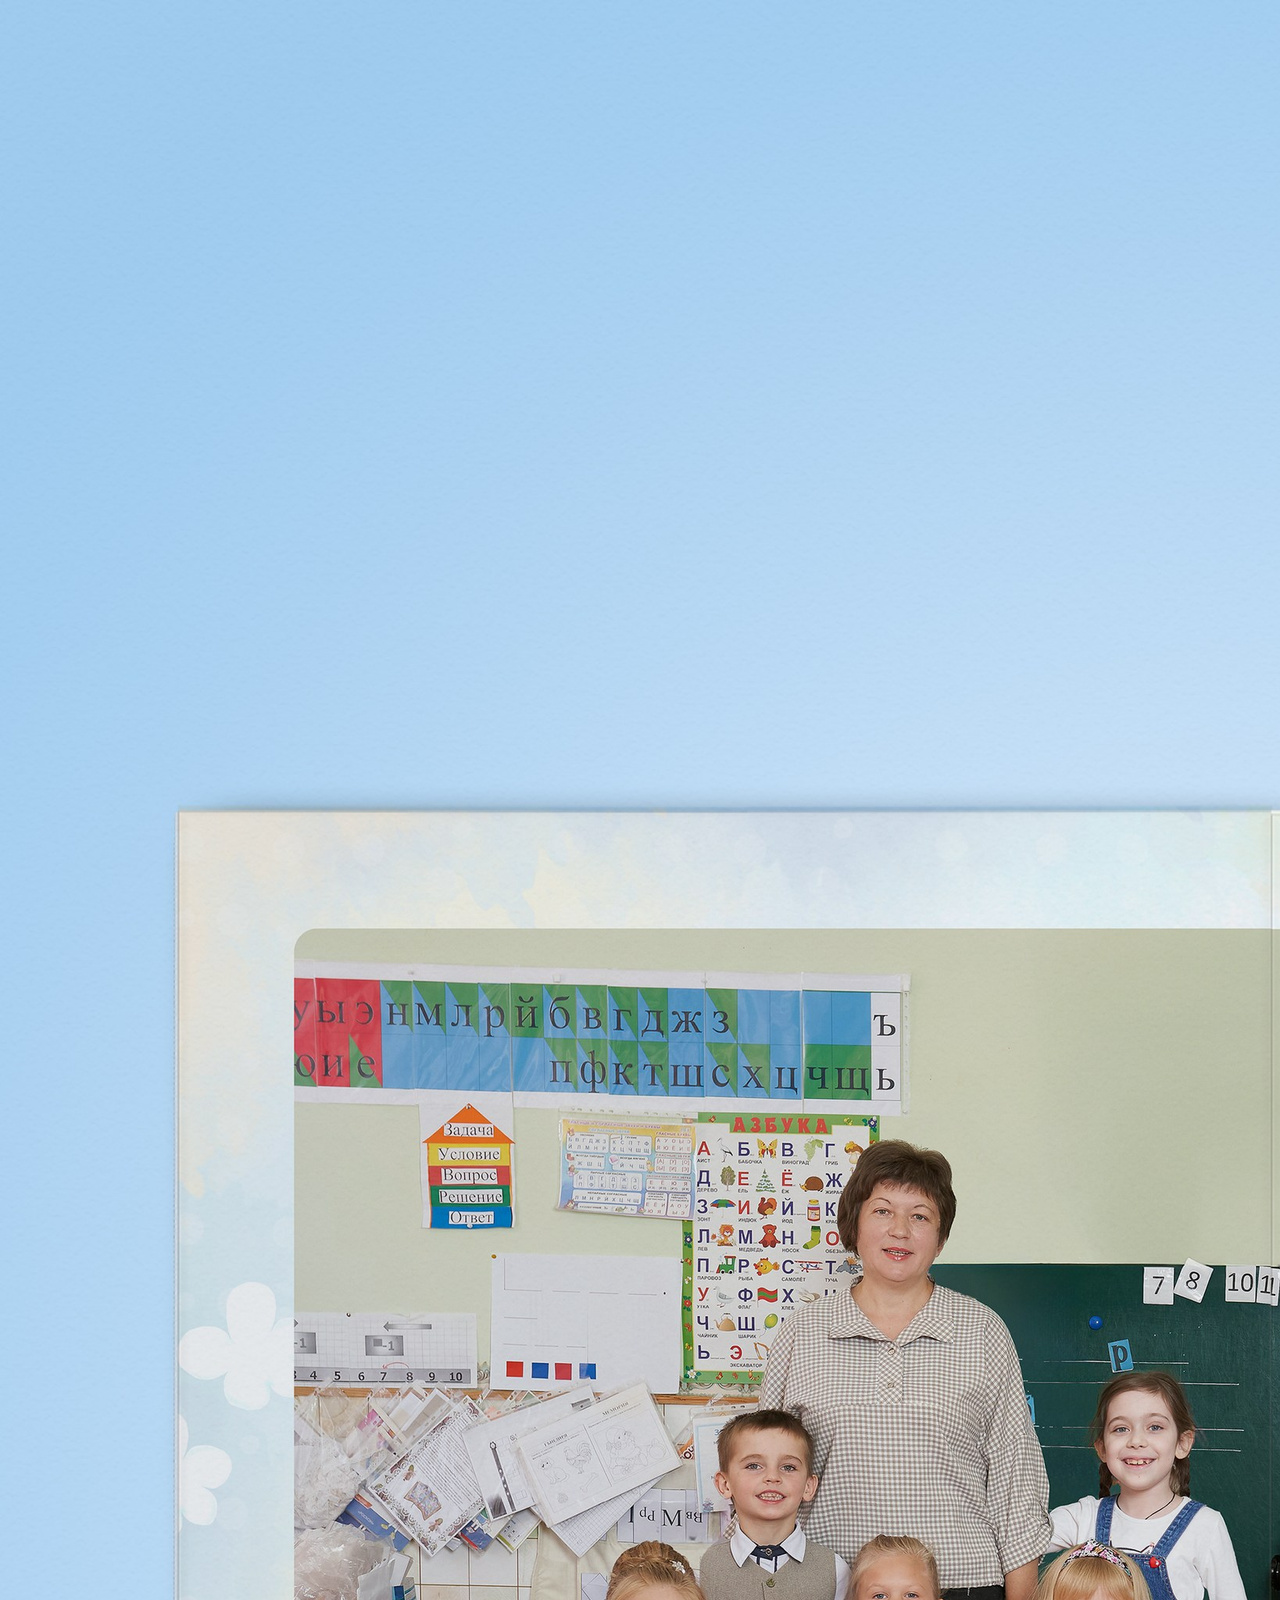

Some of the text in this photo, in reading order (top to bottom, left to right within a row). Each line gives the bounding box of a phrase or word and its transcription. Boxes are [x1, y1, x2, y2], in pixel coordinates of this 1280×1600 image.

[444, 1123, 494, 1137] Задача
[733, 1117, 828, 1134] АЗБУКА
[438, 1148, 500, 1160] Условие
[697, 1141, 711, 1155] А
[738, 1142, 750, 1156] Б
[782, 1143, 794, 1157] В
[825, 1143, 835, 1157] Г
[443, 1168, 497, 1184] Вопрос
[697, 1170, 711, 1187] Д
[738, 1171, 749, 1185] Е
[782, 1169, 793, 1186] Ё
[825, 1172, 843, 1187] Ж
[439, 1190, 503, 1203] Решение
[697, 1199, 708, 1214] З
[738, 1200, 750, 1215] И
[782, 1198, 794, 1215] Й
[825, 1202, 836, 1216] К
[450, 1211, 493, 1223] Ответ
[697, 1229, 710, 1243] Л
[739, 1229, 752, 1244] М
[782, 1230, 794, 1245] Н
[825, 1231, 839, 1246] О
[697, 1258, 709, 1272] П
[738, 1259, 750, 1273] Р
[782, 1259, 794, 1274] С
[825, 1261, 837, 1274] Т
[1152, 1276, 1164, 1295] 7
[1186, 1271, 1200, 1290] 8
[1228, 1272, 1254, 1292] 10
[1260, 1275, 1276, 1296] 11
[697, 1287, 709, 1301] У
[738, 1288, 753, 1302] Ф
[782, 1288, 794, 1303] Х
[697, 1316, 709, 1330] Ч
[738, 1316, 755, 1331] Ш
[698, 1345, 710, 1359] Ь
[730, 1345, 743, 1360] Э
[310, 1371, 463, 1381] 4 5 6 7 8 9 10
